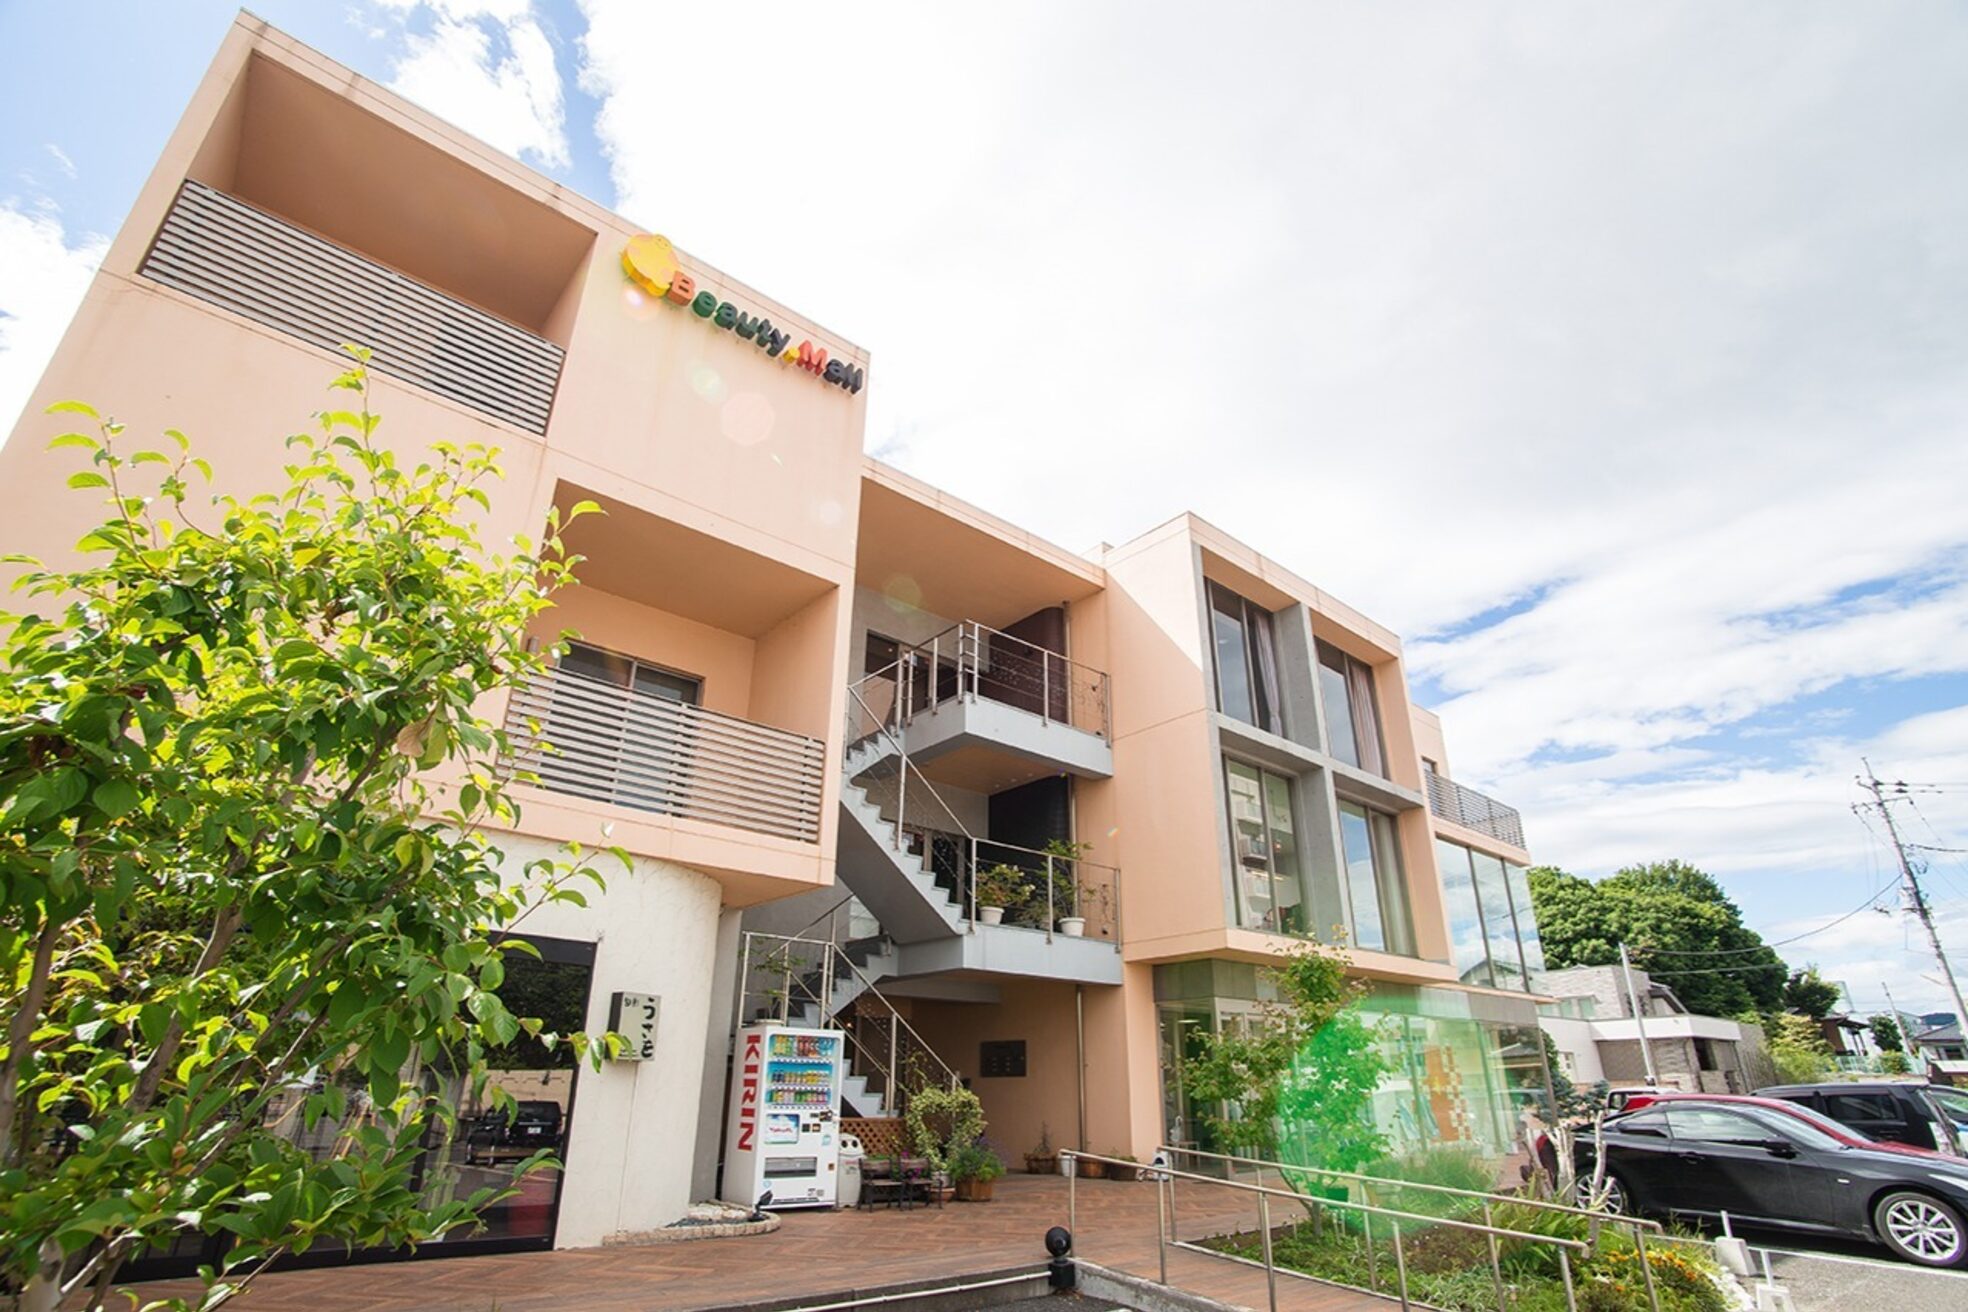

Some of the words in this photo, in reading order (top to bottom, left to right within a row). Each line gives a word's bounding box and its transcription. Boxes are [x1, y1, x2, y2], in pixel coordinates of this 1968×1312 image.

[667, 270, 791, 357] Beauty
[796, 339, 863, 395] Mall
[738, 1034, 761, 1152] KIRIN
